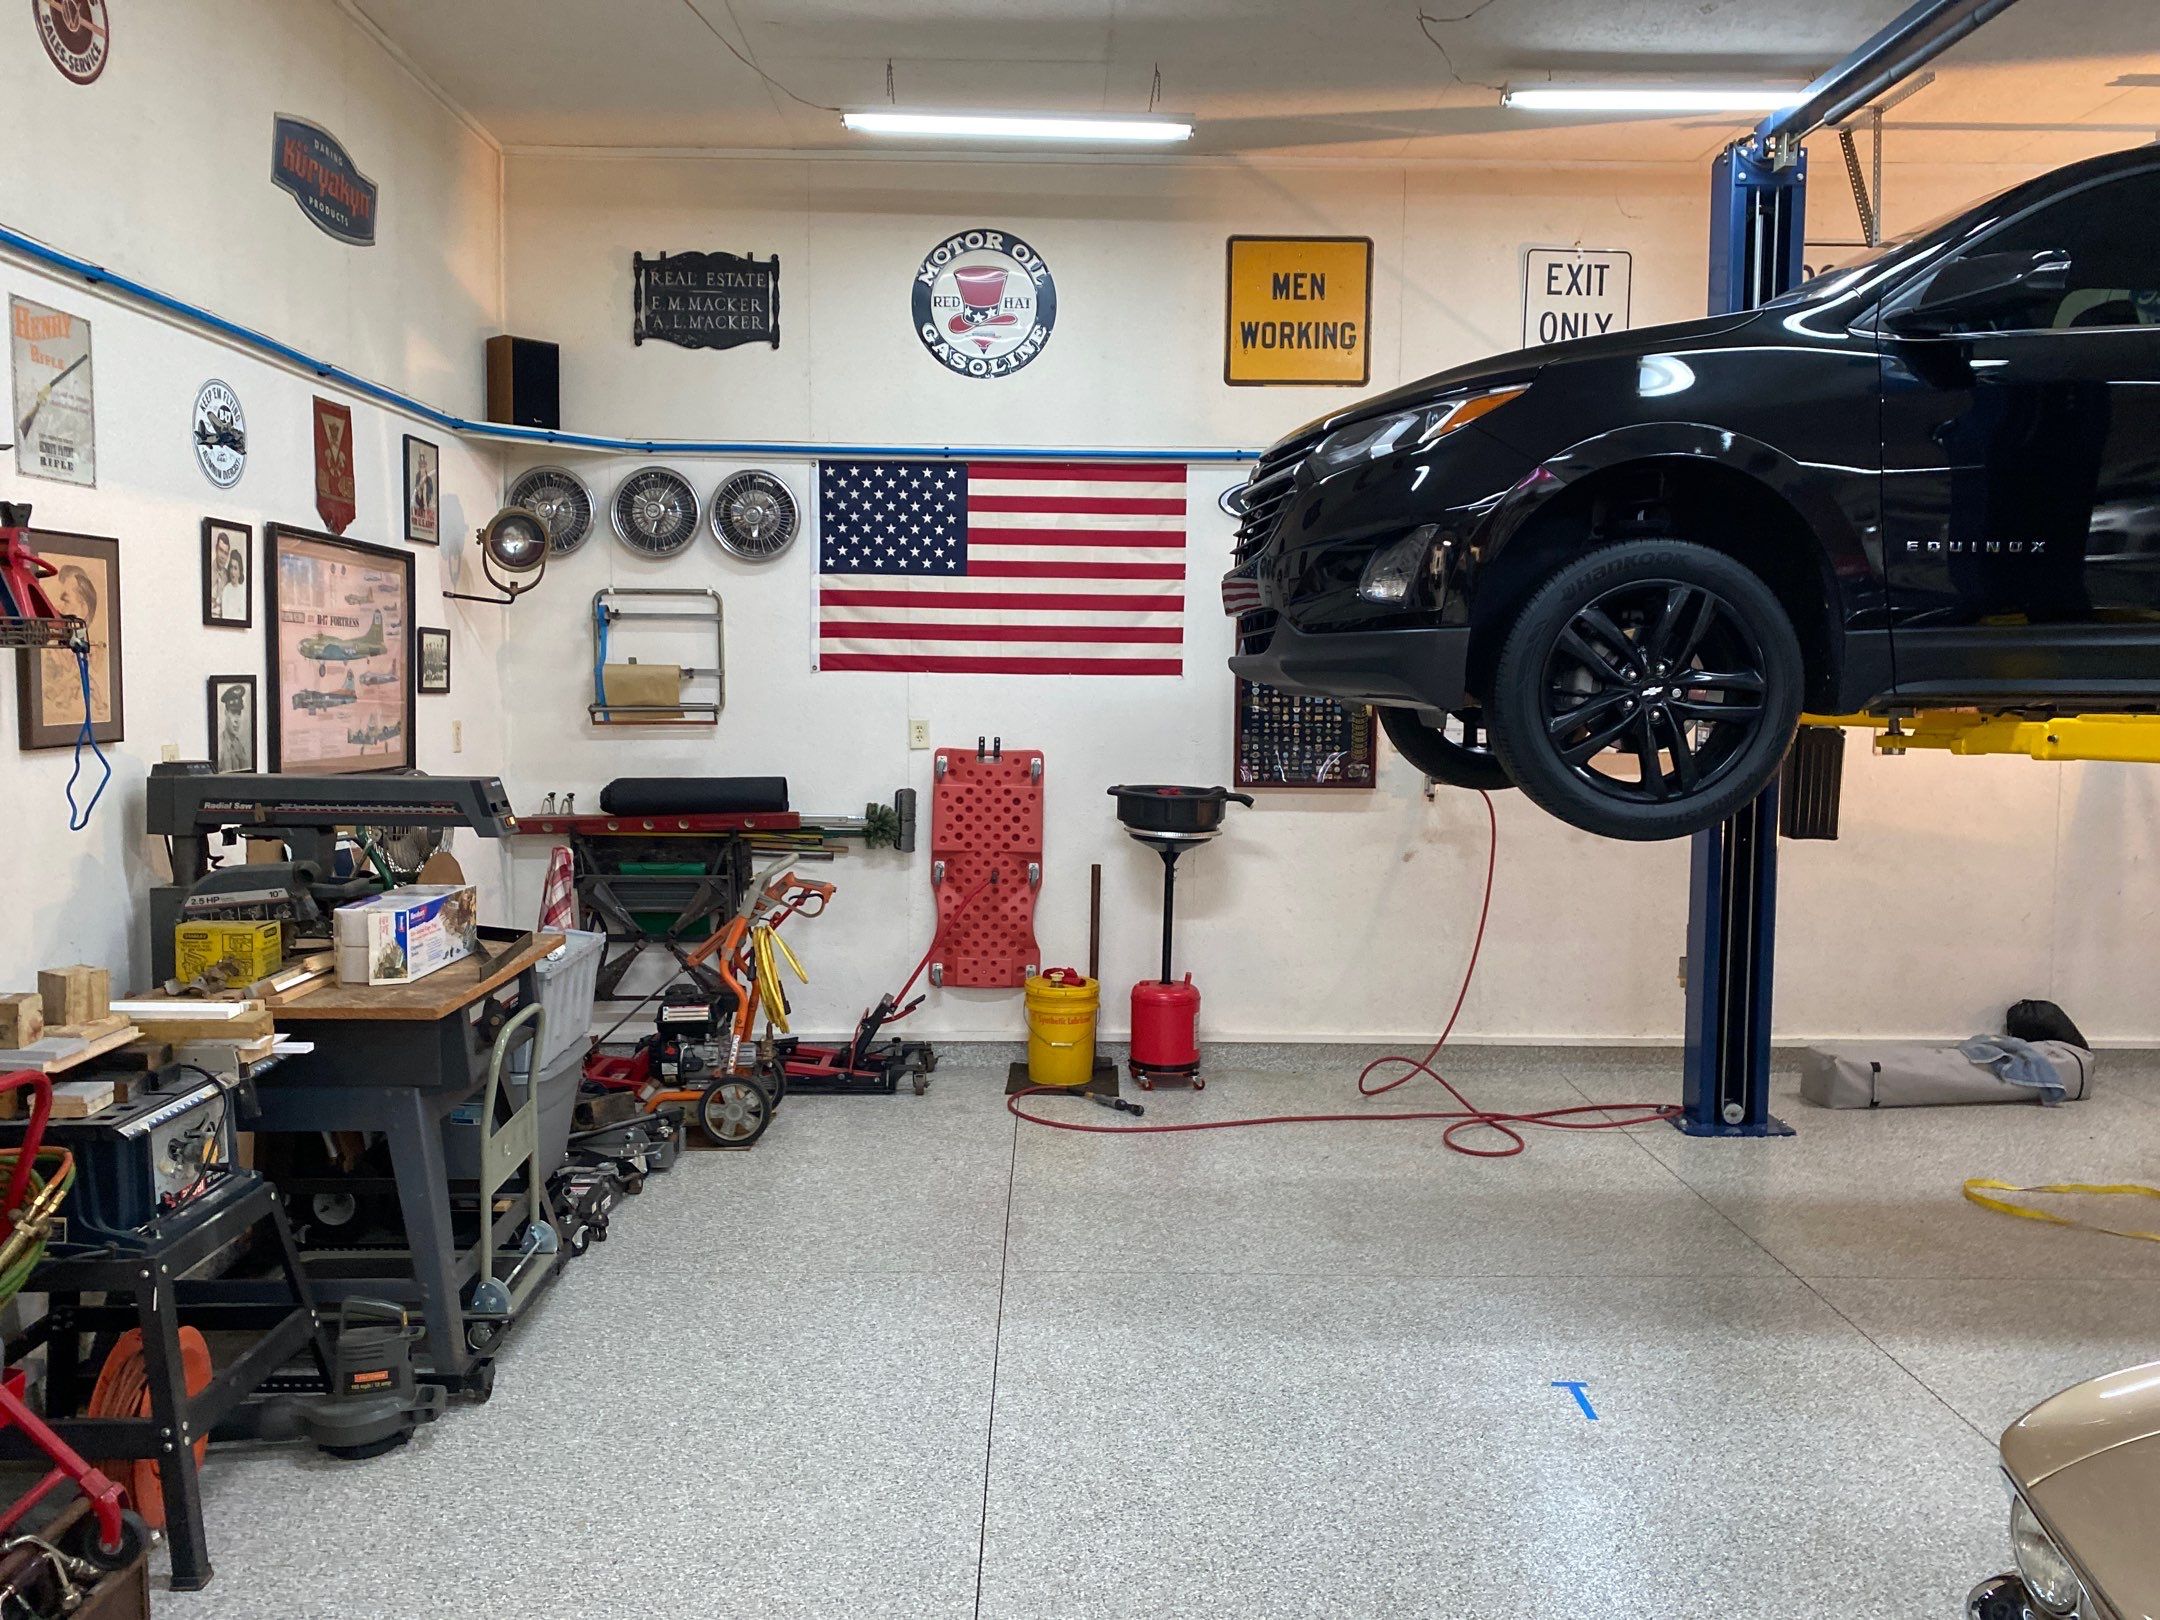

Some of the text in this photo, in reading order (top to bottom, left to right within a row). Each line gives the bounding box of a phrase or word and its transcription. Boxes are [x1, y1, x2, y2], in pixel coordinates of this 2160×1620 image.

[314, 139, 343, 167] DARING
[308, 195, 349, 227] PRODUCTS
[918, 231, 1048, 288] MOTOR OIL
[650, 271, 767, 288] REAL ESTATE
[1271, 272, 1326, 301] MEN
[1546, 262, 1610, 297] EXIT
[688, 297, 764, 313] MACKER
[933, 295, 1032, 309] RED HAT
[688, 315, 765, 331] MACKER
[1240, 321, 1357, 350] WORKING
[921, 322, 1047, 376] GASOLINE
[199, 389, 212, 413] KEEP
[223, 390, 241, 423] FLYING
[40, 456, 75, 472] RIFLE
[1906, 540, 2046, 553] EQUINOX
[330, 615, 360, 628] FORTRESS
[203, 802, 253, 810] Radial Saw
[206, 896, 220, 904] HP
